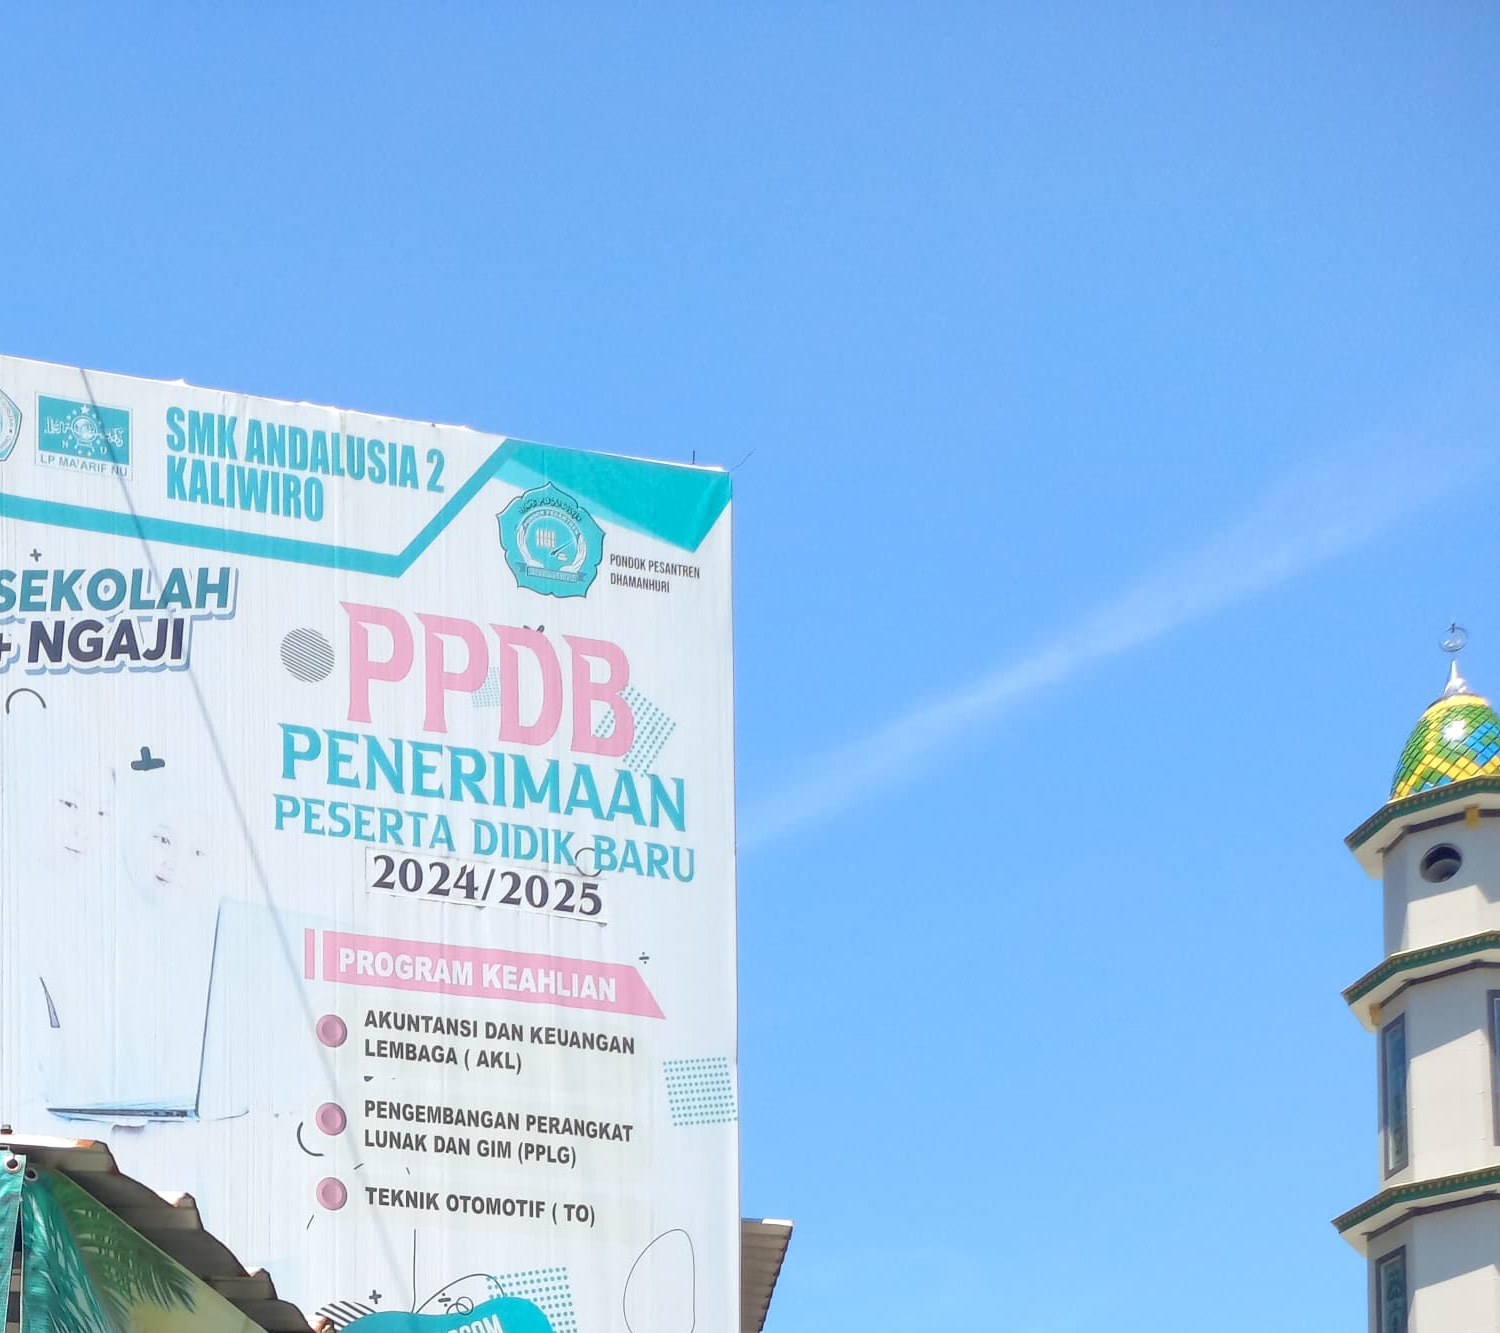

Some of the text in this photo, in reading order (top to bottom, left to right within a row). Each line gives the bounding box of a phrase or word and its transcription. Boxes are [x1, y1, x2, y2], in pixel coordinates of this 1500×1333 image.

[40, 455, 54, 465] LP
[166, 405, 237, 454] SMK
[245, 419, 419, 489] ANDALUSIA
[426, 448, 445, 493] 2
[167, 454, 325, 522] KALIWIRO
[610, 554, 700, 580] PONDOK PESANTREN
[610, 573, 670, 594] DHAMANHURI
[26, 618, 189, 666] NGAJI
[339, 601, 636, 758] PPDB
[279, 722, 686, 832] PENERIMAAN
[273, 794, 696, 883] PESERTA DIDIK BARU
[372, 854, 604, 916] 2024/2025
[338, 947, 616, 1002] PROGRAM KEAHLIAN
[364, 1010, 635, 1055] AKUNTANSI DAN KEUANGAN
[364, 1039, 458, 1066] LEMBAGA
[364, 1100, 634, 1143] PENGEMBANGAN PERANGKAT
[364, 1129, 578, 1169] LUNAK DAN GIM (PPLG)
[365, 1186, 440, 1212] TEKNIK
[445, 1193, 546, 1219] OTOMOTIF
